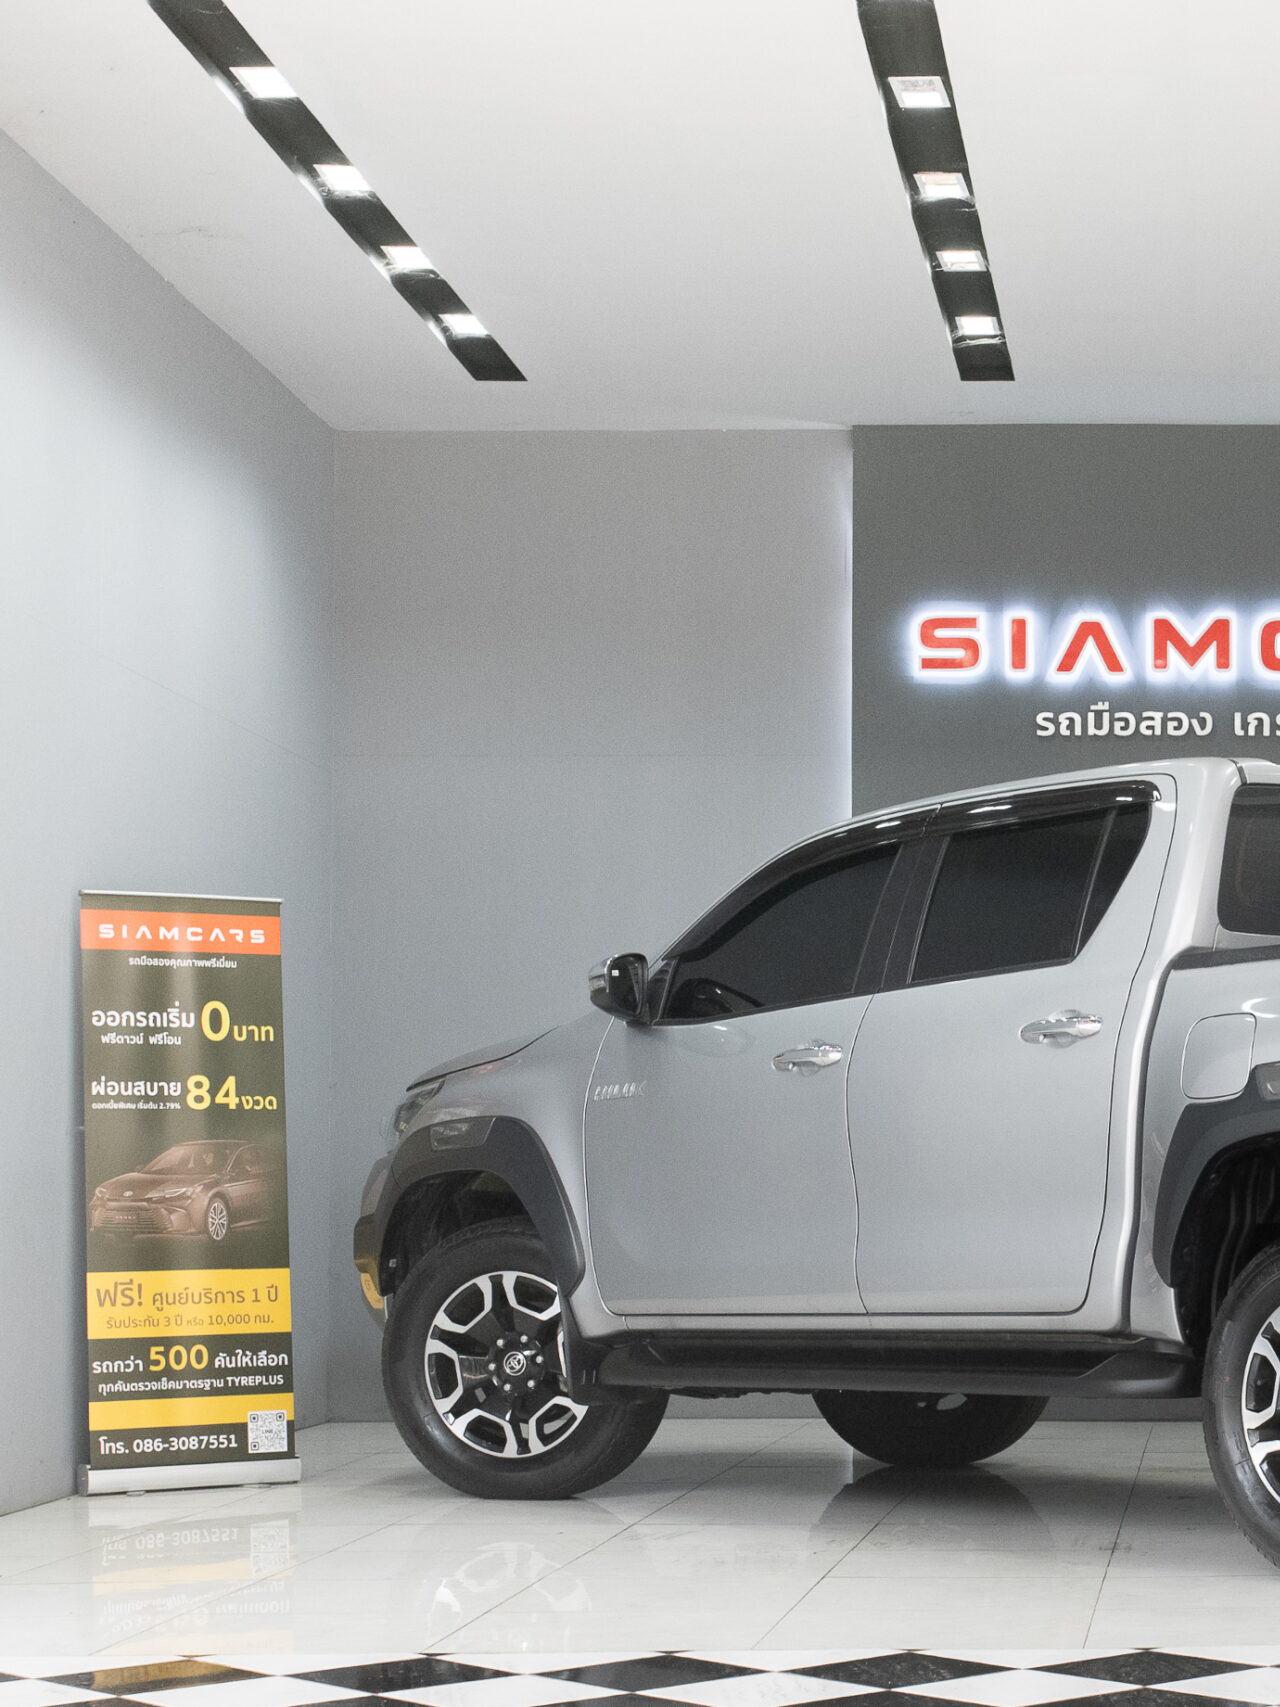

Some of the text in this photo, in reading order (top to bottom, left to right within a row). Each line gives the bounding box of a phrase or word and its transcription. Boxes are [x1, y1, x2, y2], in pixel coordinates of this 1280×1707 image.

[1035, 702, 1213, 738] รถมือสอง
[99, 923, 265, 943] SIAMCARS
[91, 1000, 275, 1042] ออกรถเริ่ม 0 บาท
[101, 1032, 182, 1045] ฟรีดาวน์ ฟรีโอน
[91, 1075, 278, 1110] ผ่อนสบาย 84 งวด
[96, 1279, 279, 1311] ฟรี! ศูนย์บริการ 1 ปี
[106, 1314, 160, 1329] รับประกัน
[163, 1316, 171, 1327] 3
[174, 1315, 184, 1327] ปี
[208, 1314, 250, 1328] 10,000
[254, 1314, 275, 1325] กม.
[92, 1344, 289, 1374] รถกว่า 500 คันให้เลือก
[98, 1374, 284, 1396] ทุกคันตรวจเช็คมาตรฐาน TYREPLUS
[99, 1434, 238, 1455] โทร. 086-3087551
